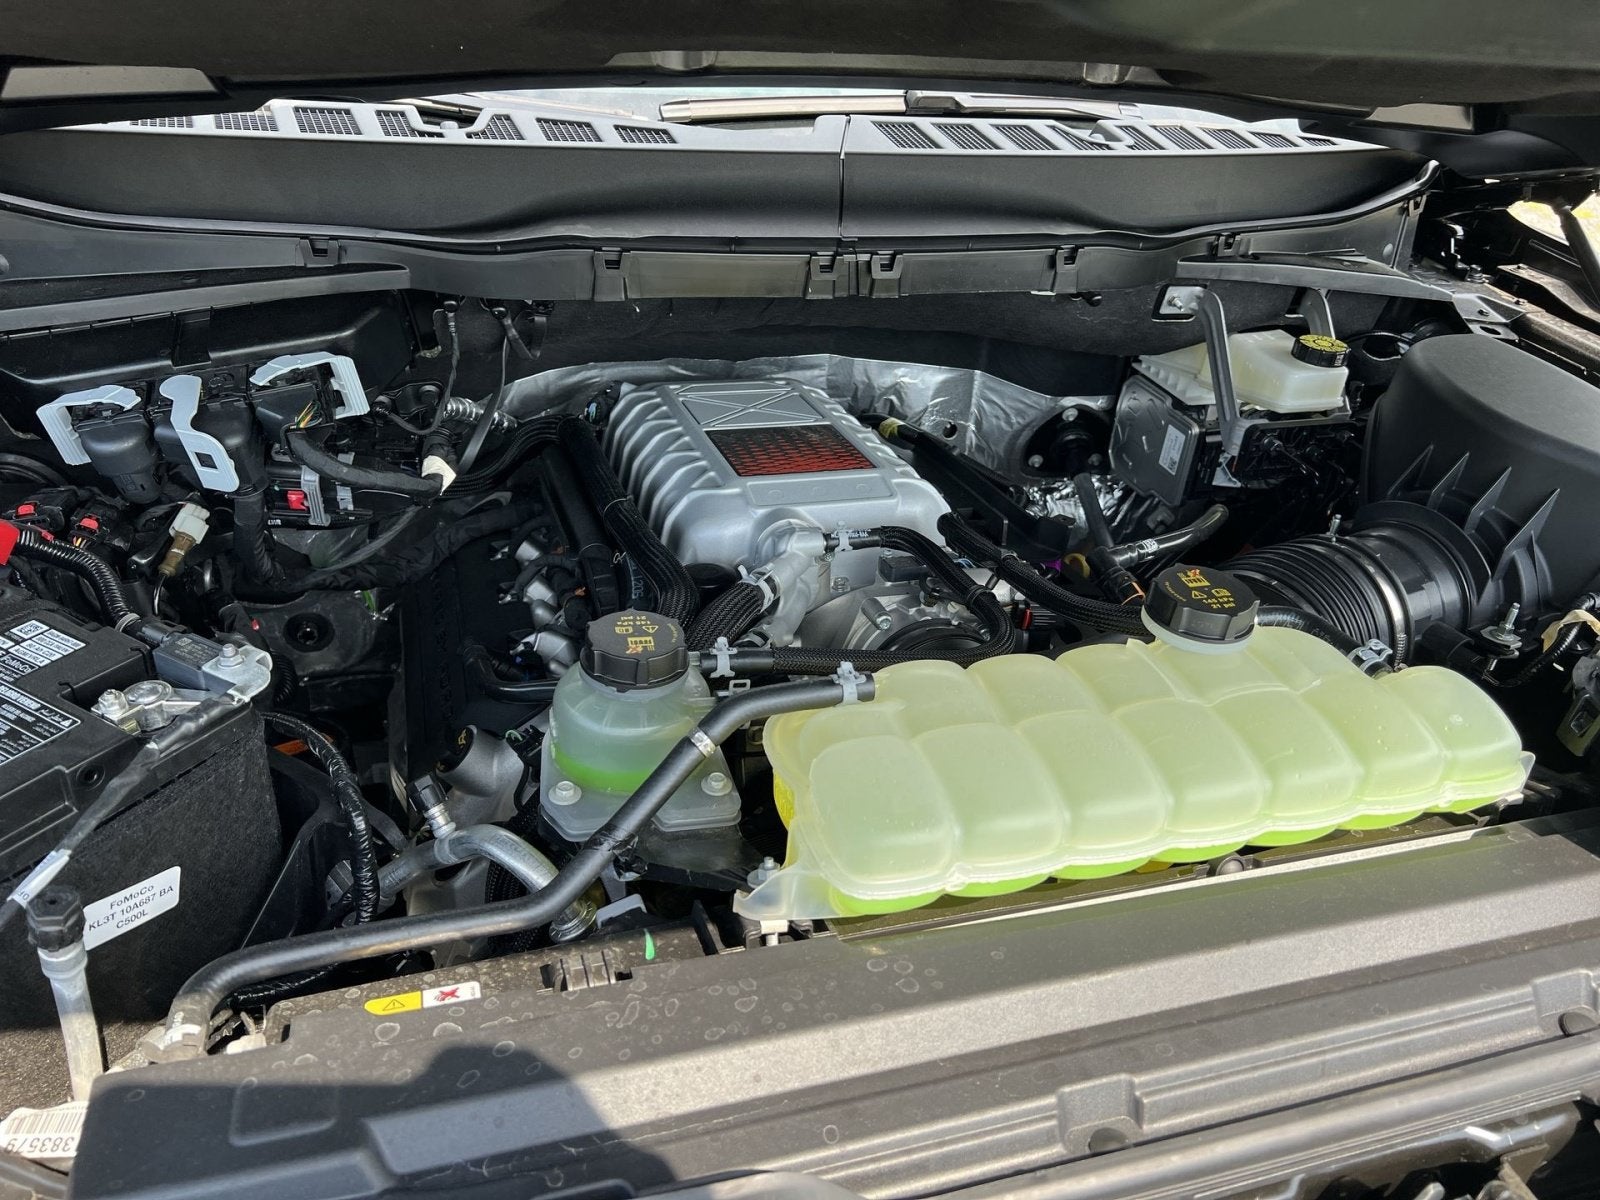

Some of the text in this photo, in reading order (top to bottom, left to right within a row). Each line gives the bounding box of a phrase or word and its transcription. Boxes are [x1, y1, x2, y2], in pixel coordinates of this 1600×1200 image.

[1, 656, 32, 673] FoMoCo
[88, 885, 174, 931] KL3T 10A687 BA
[110, 885, 154, 910] FoMoCo
[116, 909, 149, 929] C500L
